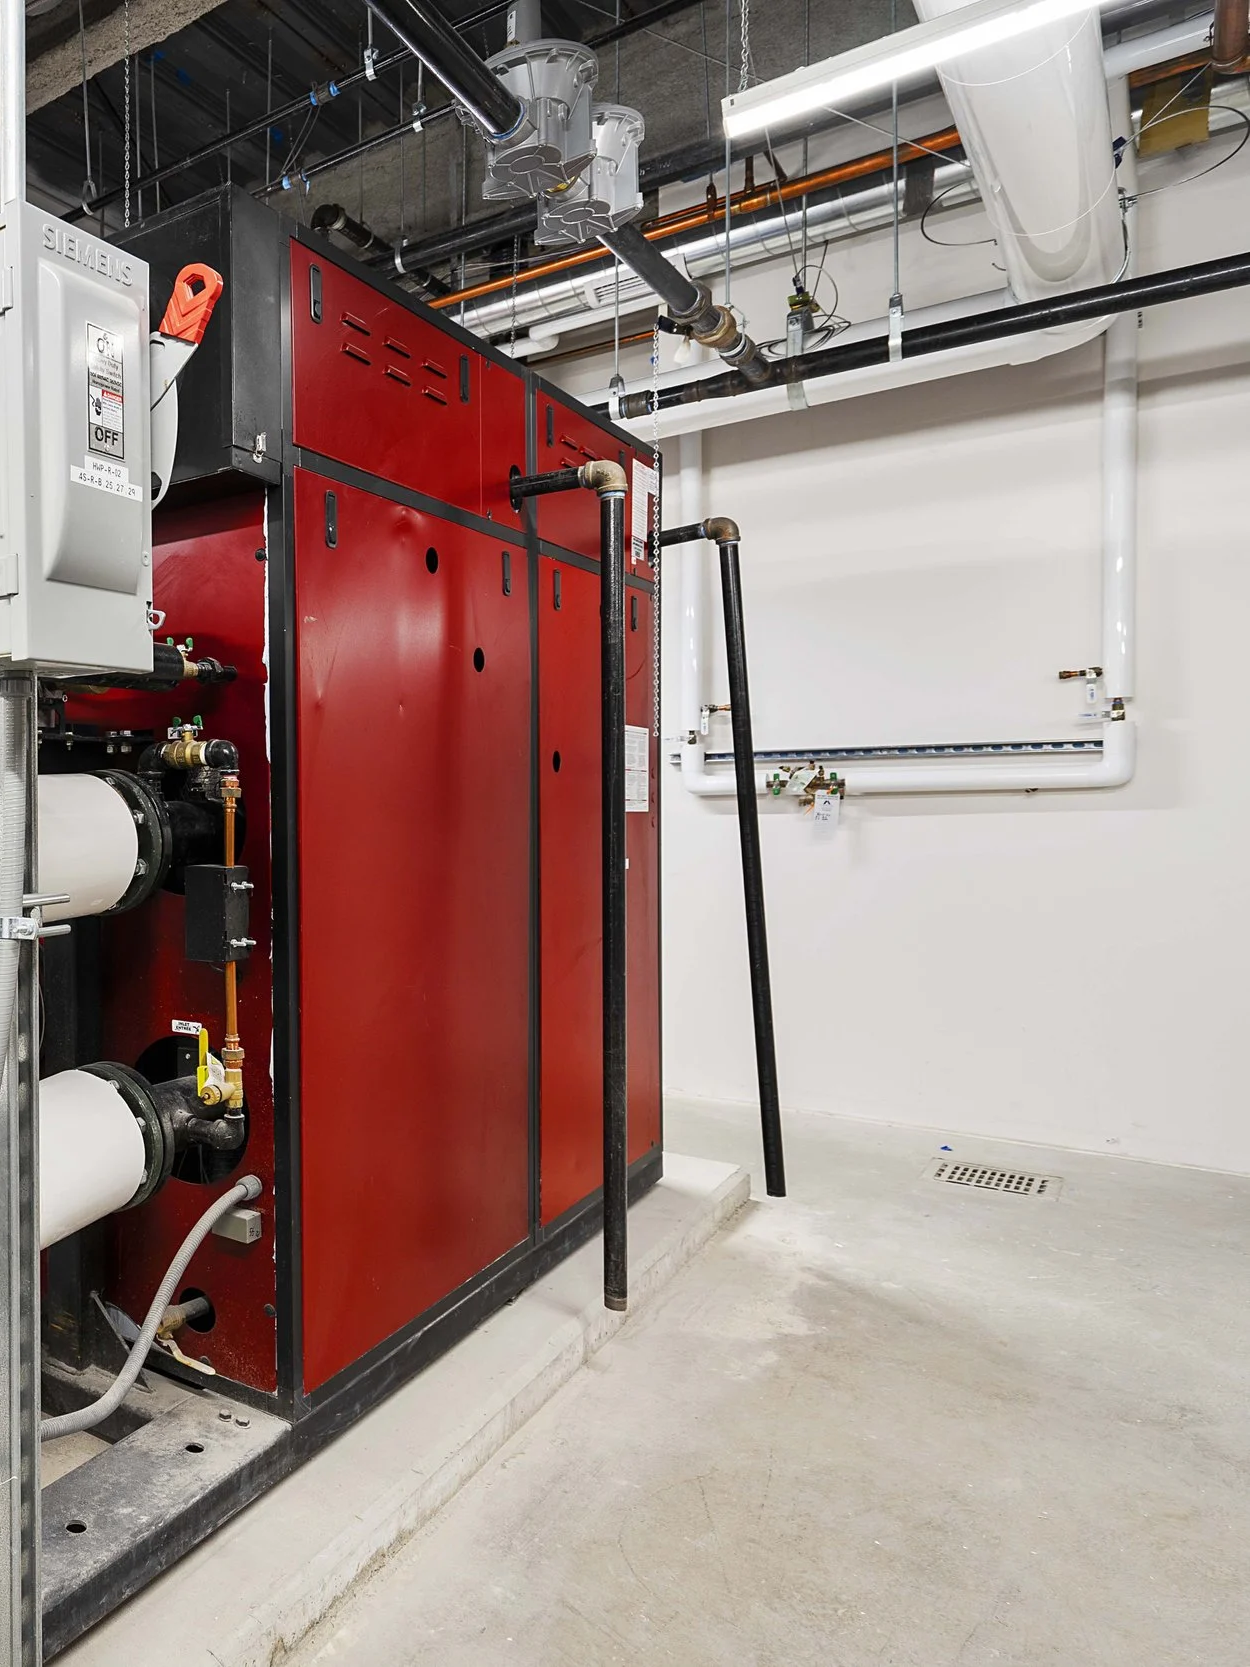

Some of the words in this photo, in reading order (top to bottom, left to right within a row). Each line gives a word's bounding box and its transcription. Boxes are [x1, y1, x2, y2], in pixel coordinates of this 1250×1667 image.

[42, 223, 133, 286] SIEMENS
[94, 426, 119, 446] OFF
[92, 462, 121, 478] HWP-R-02
